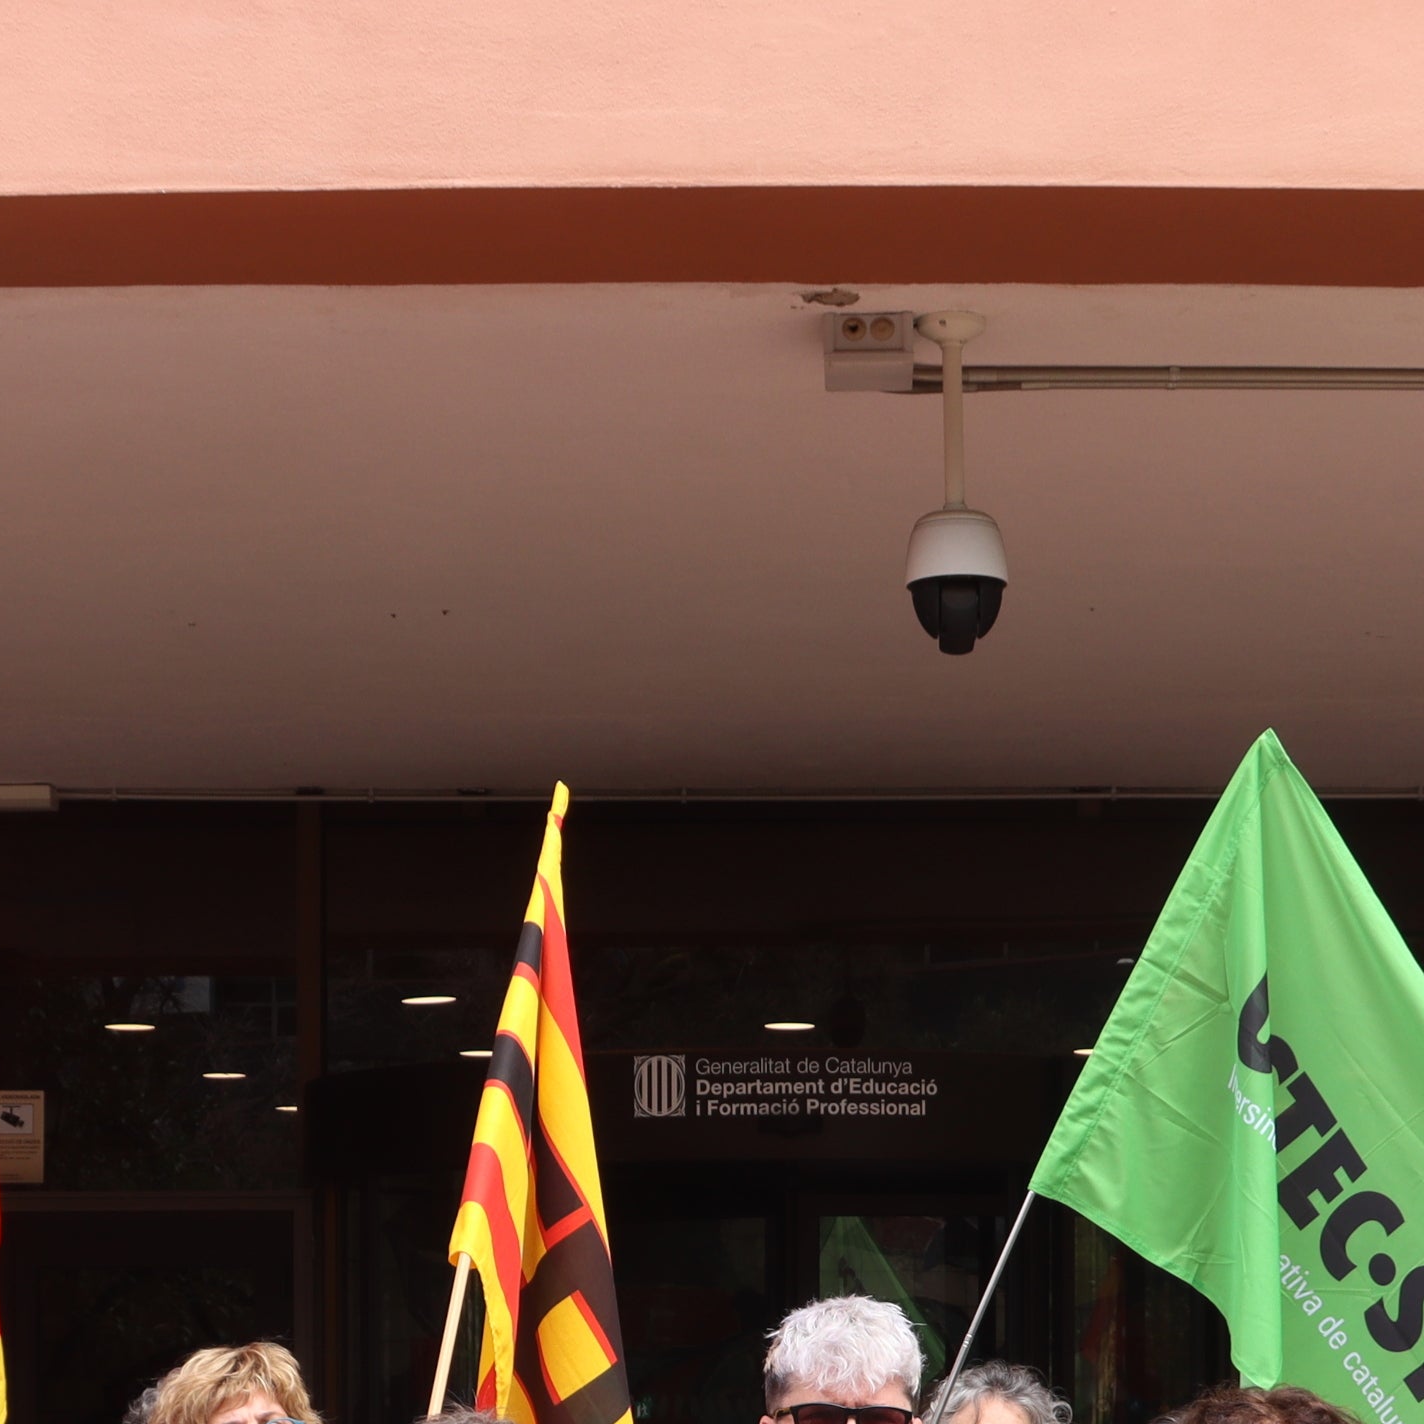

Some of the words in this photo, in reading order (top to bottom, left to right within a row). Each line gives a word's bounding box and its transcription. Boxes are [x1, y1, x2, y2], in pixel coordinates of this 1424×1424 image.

[695, 1058, 790, 1074] Generalitat
[797, 1057, 819, 1074] de
[825, 1057, 912, 1076] Catalunya
[696, 1080, 824, 1099] Departament
[830, 1079, 938, 1096] d'Educació
[696, 1101, 701, 1116] i
[707, 1099, 799, 1116] Formació
[806, 1099, 926, 1116] Professional
[1318, 1315, 1348, 1350] de
